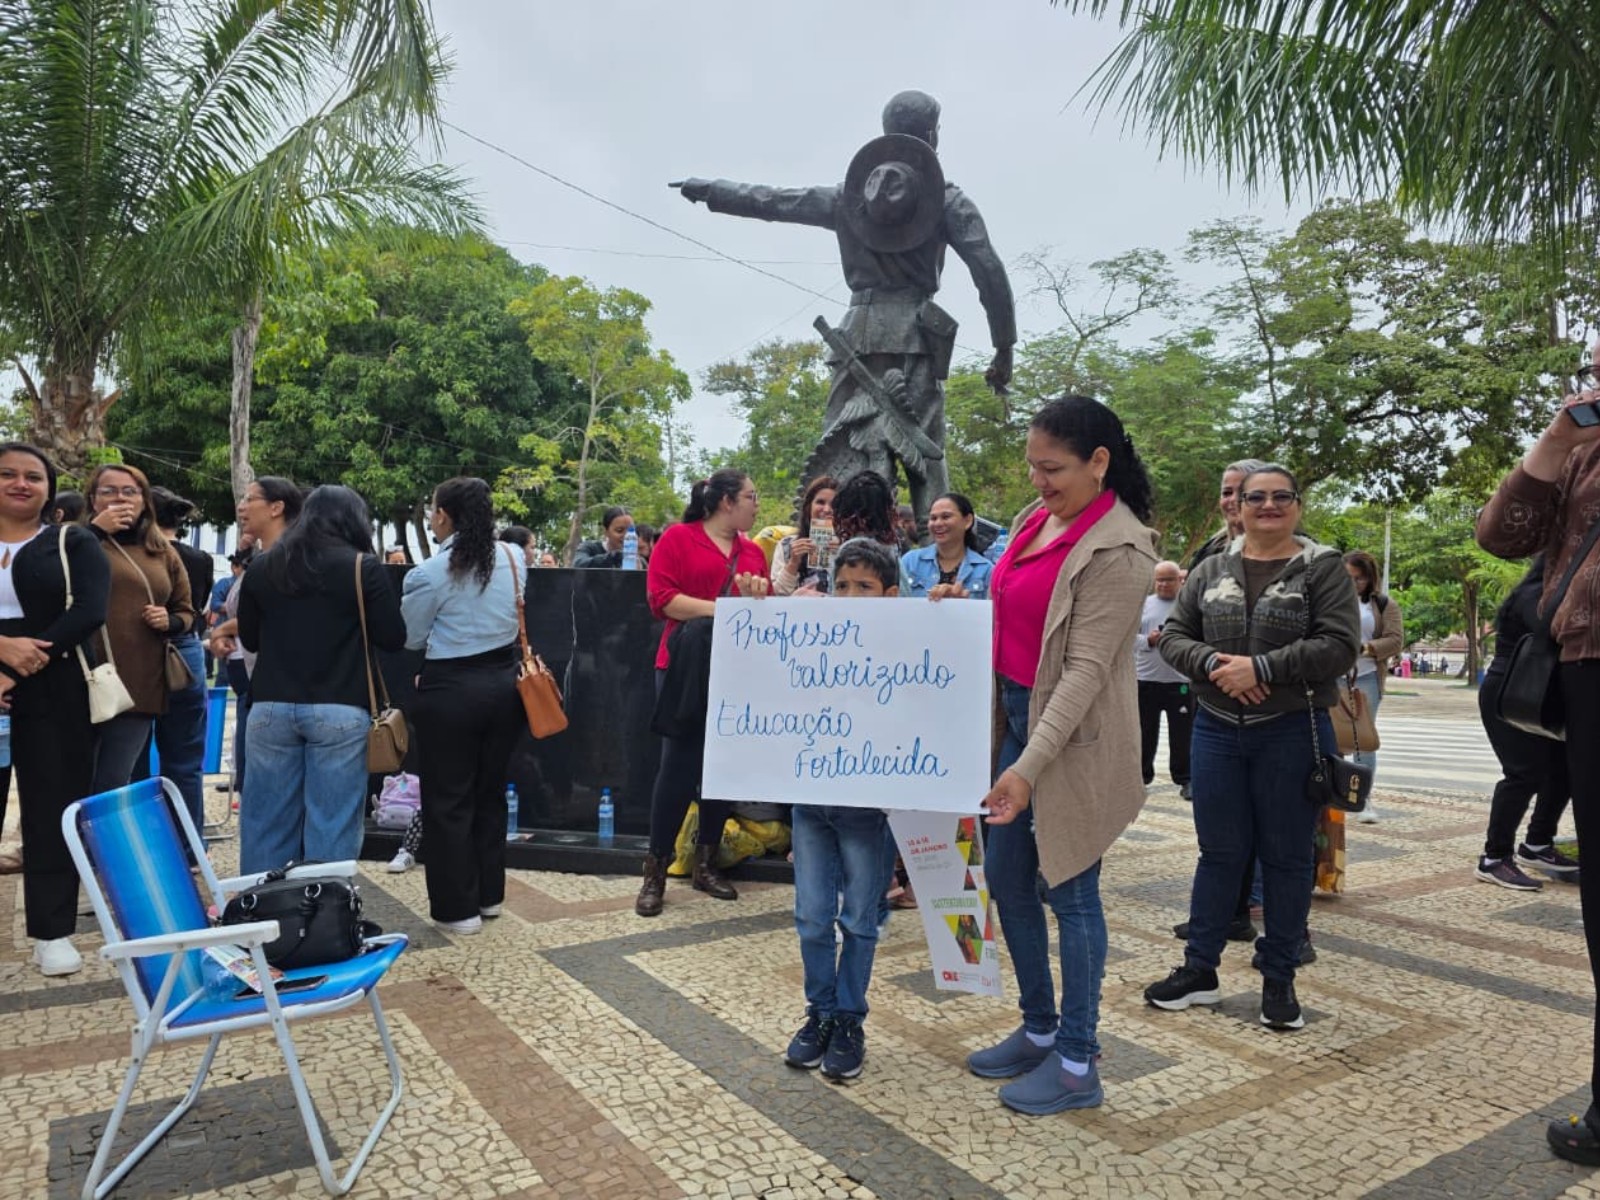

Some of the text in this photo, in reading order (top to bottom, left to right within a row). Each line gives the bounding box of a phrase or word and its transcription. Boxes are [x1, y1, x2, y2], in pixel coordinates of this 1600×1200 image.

[727, 608, 863, 661] Professor
[717, 699, 852, 746] Educação
[795, 737, 948, 778] Fortalecida
